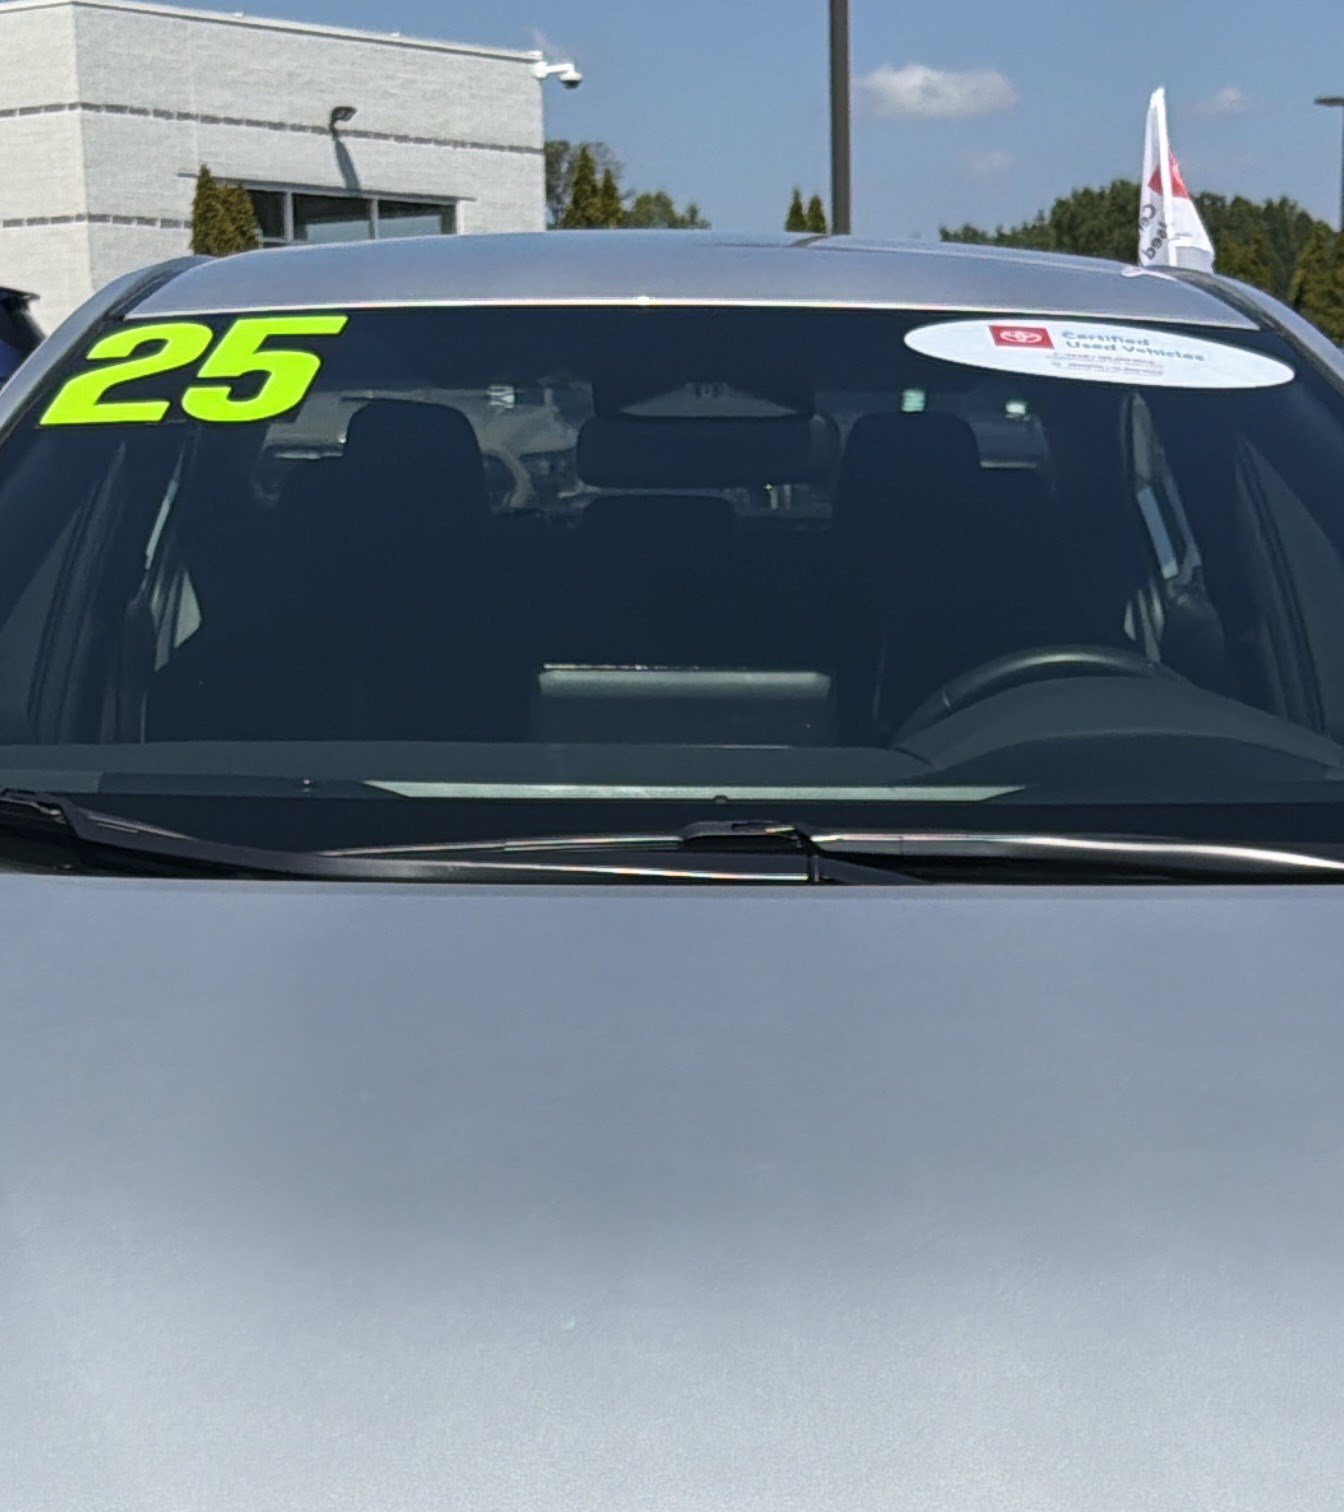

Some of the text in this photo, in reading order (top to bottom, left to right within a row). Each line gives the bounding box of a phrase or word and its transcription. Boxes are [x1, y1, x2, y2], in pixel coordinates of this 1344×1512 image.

[1062, 331, 1149, 345] Certified
[1065, 341, 1116, 351] Used
[1121, 345, 1204, 360] Vehicles
[39, 316, 349, 425] 25
